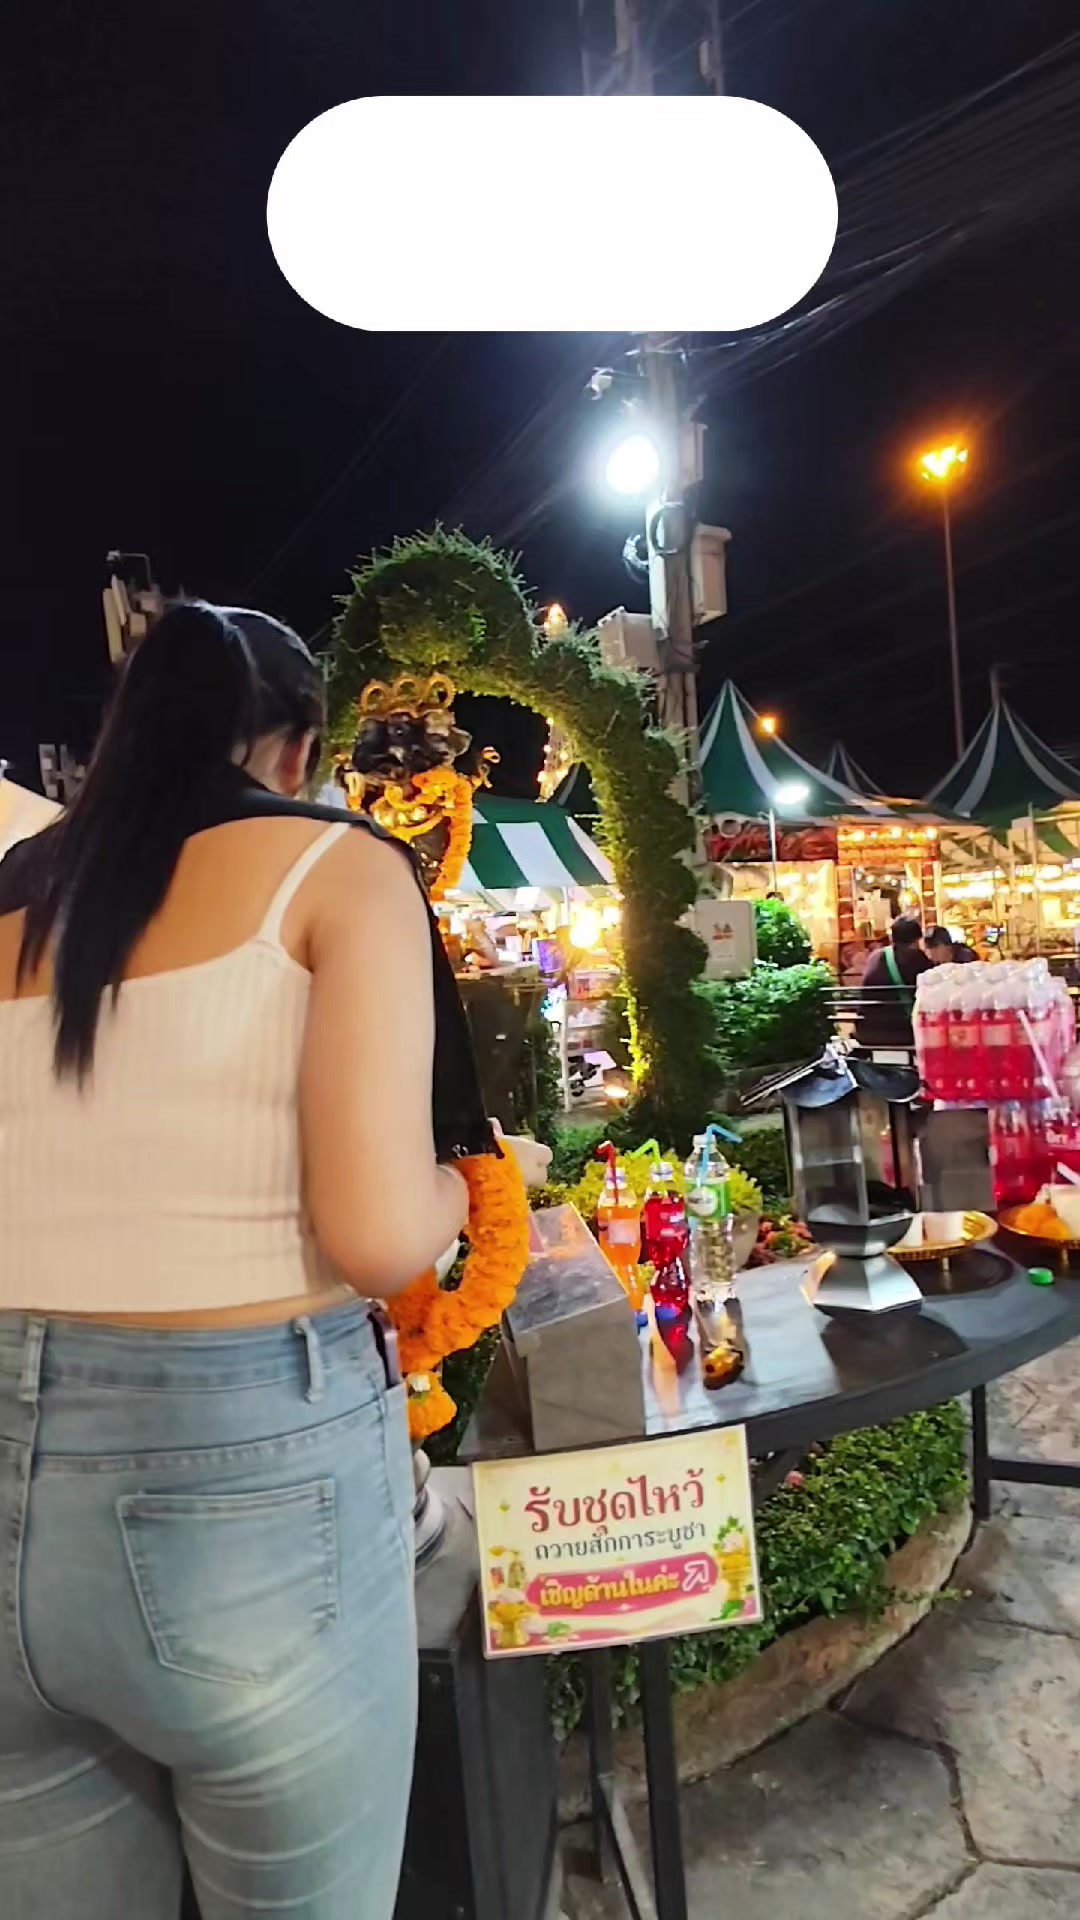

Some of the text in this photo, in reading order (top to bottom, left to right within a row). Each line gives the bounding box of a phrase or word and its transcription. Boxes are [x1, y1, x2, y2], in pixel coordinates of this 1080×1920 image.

[524, 1467, 704, 1535] รับชุดไหว้
[534, 1521, 706, 1560] ถวายสักการะบูชา
[540, 1564, 679, 1609] เชิญด้านในค่ะ
